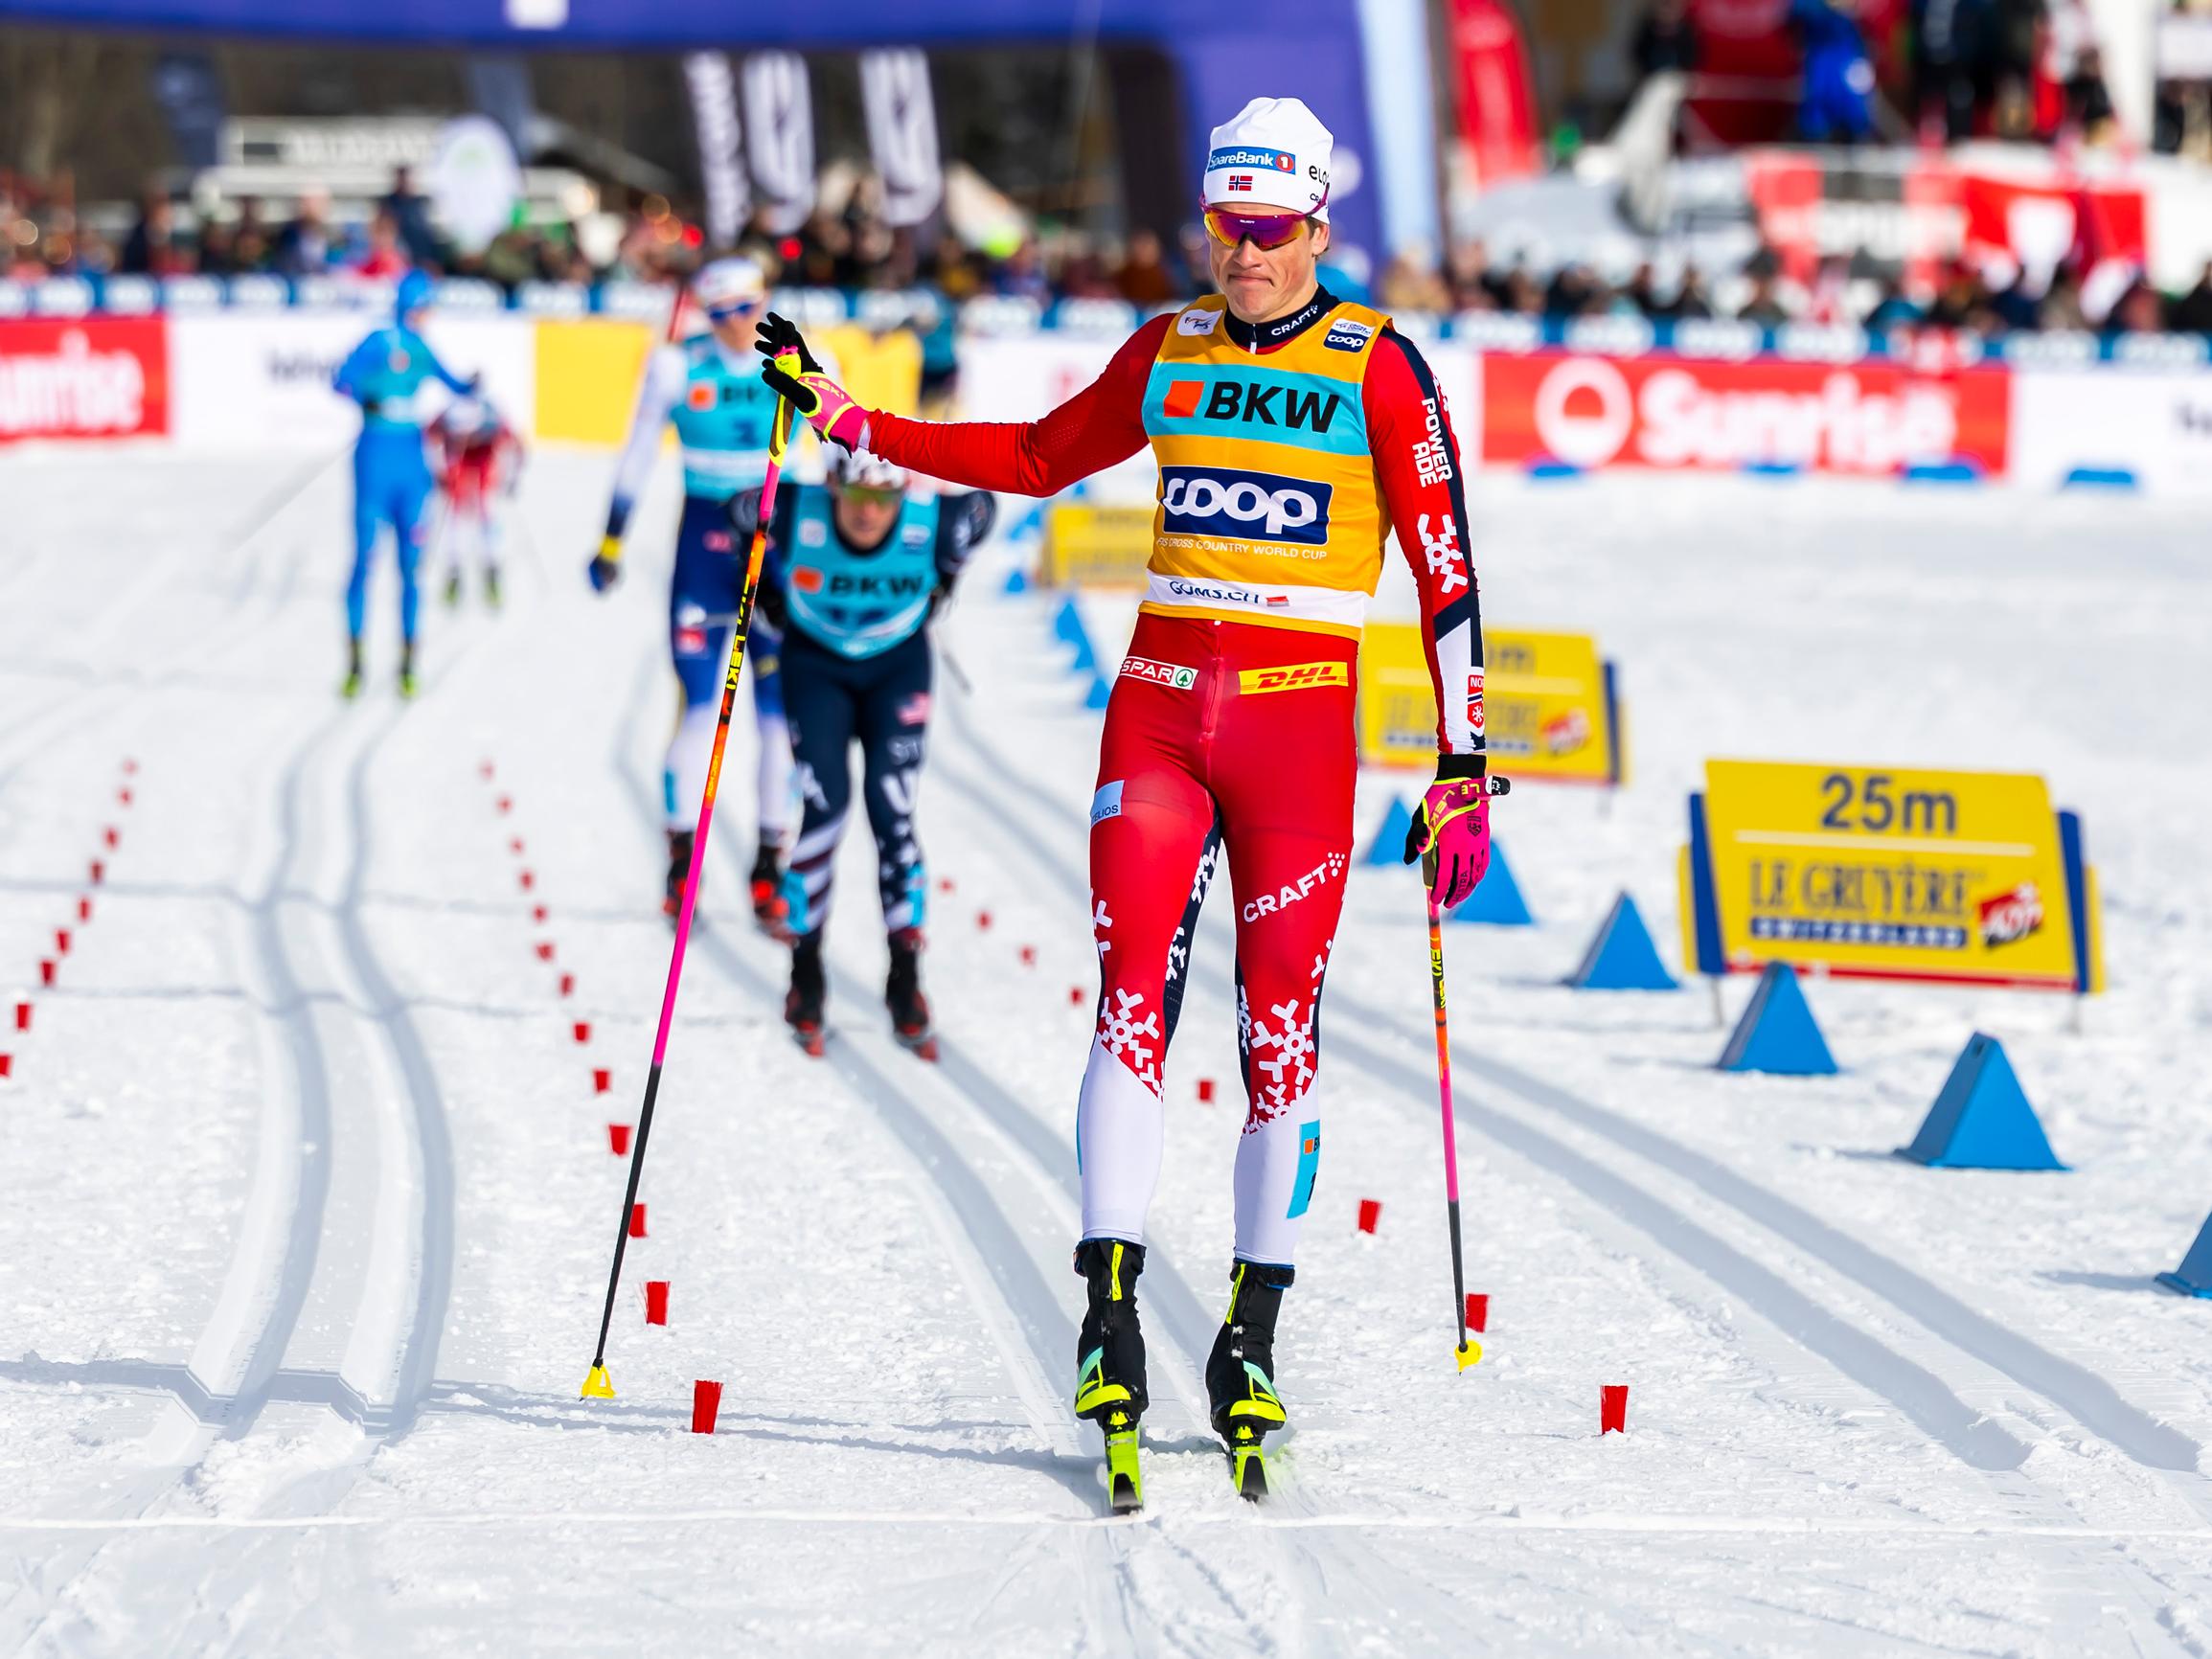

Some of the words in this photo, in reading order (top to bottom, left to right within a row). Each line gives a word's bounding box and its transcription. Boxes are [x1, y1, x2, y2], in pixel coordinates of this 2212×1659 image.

[1210, 151, 1274, 169] SpareBank
[1271, 309, 1311, 336] CRAFT
[1327, 334, 1364, 348] coop
[1204, 381, 1340, 434] BKW
[1422, 398, 1453, 483] POWER
[1412, 442, 1439, 489] ADE
[1162, 477, 1318, 535] coop
[1196, 540, 1250, 554] COUNTRY
[1253, 544, 1299, 558] WORLD
[1301, 549, 1328, 561] CUP
[725, 634, 747, 691] LEKI
[1121, 660, 1173, 682] SPAR
[1257, 666, 1339, 689] DHL
[1821, 773, 1958, 833] 25m
[1243, 862, 1327, 922] CRAFT
[1749, 858, 1791, 908] LE
